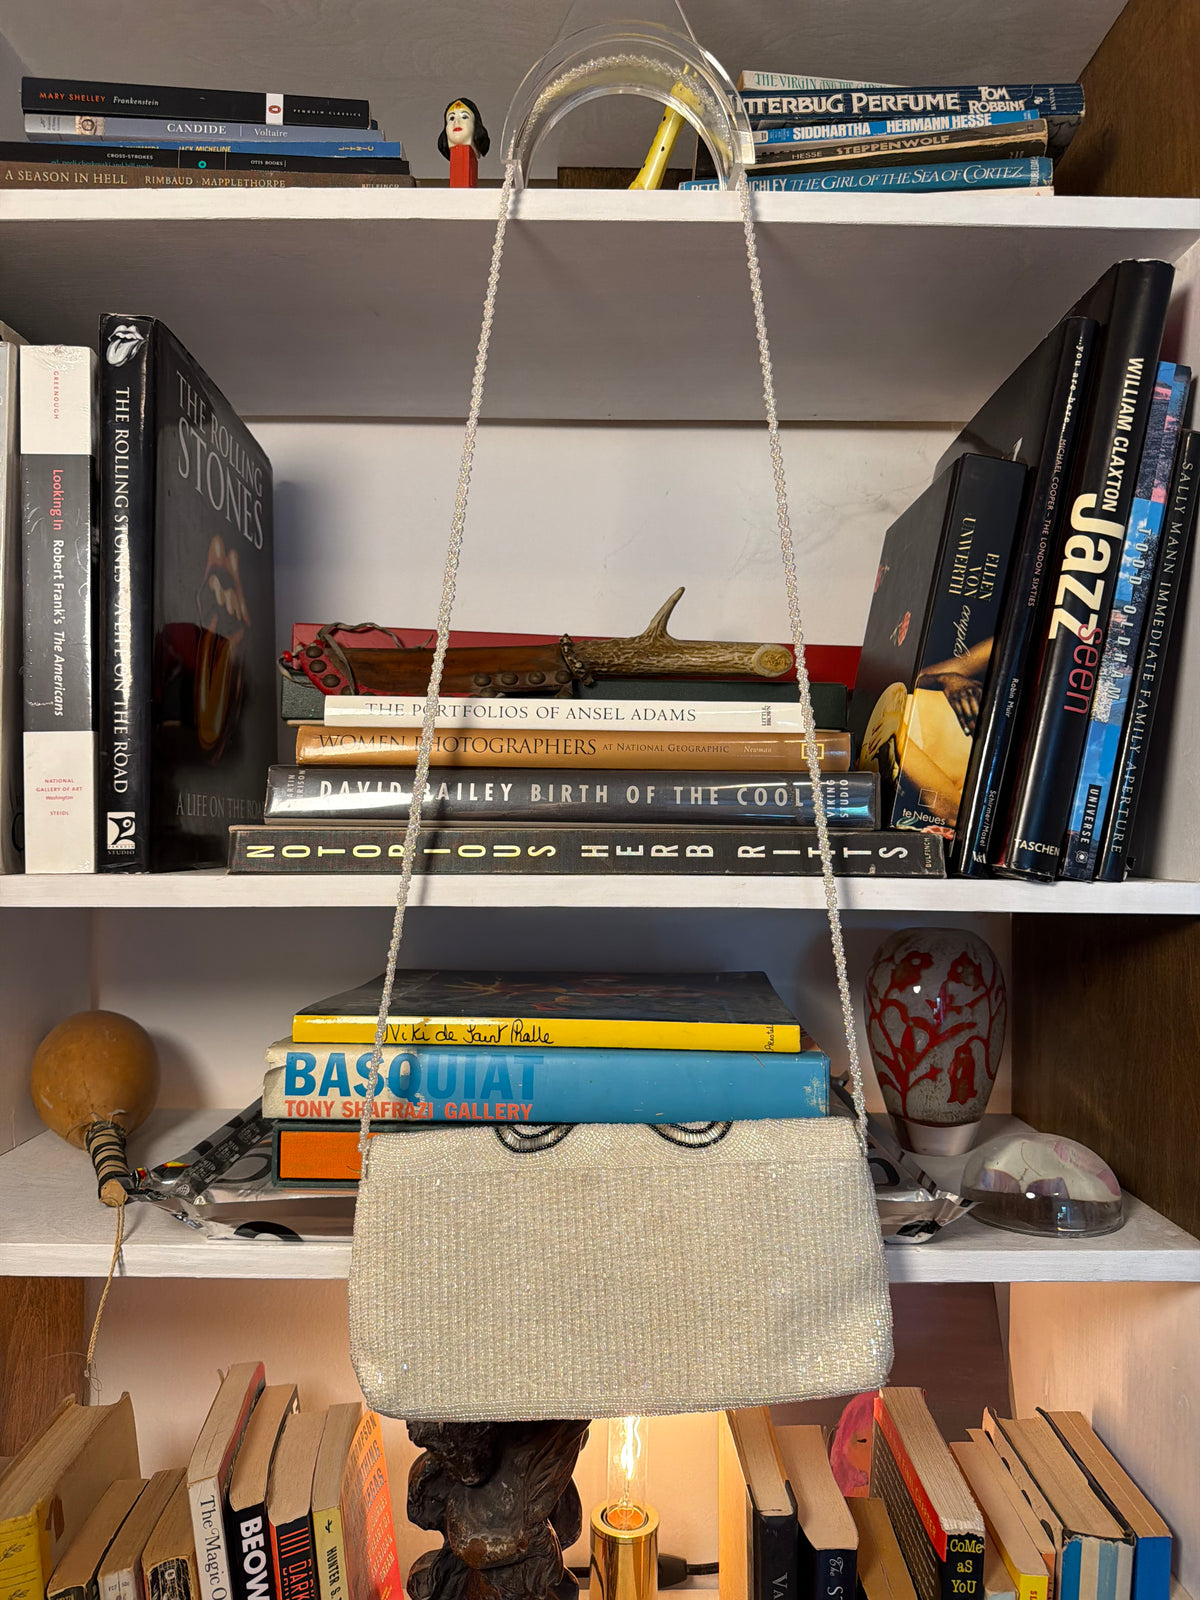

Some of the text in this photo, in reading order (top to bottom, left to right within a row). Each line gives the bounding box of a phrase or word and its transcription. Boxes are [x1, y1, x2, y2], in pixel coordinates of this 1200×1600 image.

[754, 73, 777, 87] THE
[778, 74, 817, 90] VIRGIN
[977, 86, 1010, 101] TOM
[40, 92, 159, 106] MARY SHELLEY Frankenstein
[852, 92, 960, 113] PERFUME
[967, 99, 1026, 114] ROBBINS
[167, 123, 288, 137] CANDIDE Voltaire
[793, 123, 872, 140] SIDDHARTHA
[886, 117, 950, 133] HERMANN
[951, 113, 992, 130] HESSE
[106, 153, 154, 161] CROSS-STROKES
[195, 145, 231, 153] MICHELINE
[792, 135, 950, 160] HESSE STEPPENWOLF
[5, 170, 286, 188] A SEASON IN HELL RIMBAUD MAPPLETHORPE
[789, 178, 820, 191] THE
[820, 175, 863, 191] GIRL
[883, 172, 912, 186] THE
[912, 169, 939, 184] SEA
[940, 169, 963, 182] OF
[963, 165, 1024, 183] CORTEZ
[115, 387, 130, 422] THE
[176, 369, 263, 498] THE ROLLING
[1101, 357, 1145, 513] WILLIAM CLAXTON
[114, 429, 129, 508] ROLLING
[1054, 438, 1067, 474] MICHAEL
[178, 416, 263, 550] STONES
[1049, 476, 1060, 511] COOPER
[1041, 519, 1051, 535] THE
[114, 514, 129, 583] STONES
[948, 516, 976, 595] UNWERTH
[1034, 537, 1048, 575] LONDON
[963, 566, 982, 598] VON
[979, 552, 1000, 601] ELLEN
[1047, 493, 1125, 646] Jazz
[50, 469, 66, 717] Looking In Robert Frank's The Americans
[1027, 577, 1040, 607] SIXTIES
[1106, 604, 1137, 702] OLDHAM
[1111, 461, 1194, 853] SALLY MANN IMMEDIATE FAMILY APERTURE
[114, 663, 129, 691] ON
[365, 703, 697, 721] THE PRTFOLIOS OF ANSEL ADAMS
[1004, 677, 1019, 718] Robin Muir
[114, 699, 129, 735] THE
[319, 734, 405, 749] WOMEN
[602, 744, 613, 752] AT
[616, 743, 664, 752] NATIONAL
[667, 743, 729, 753] GEOGRAPHIC
[114, 741, 129, 794] ROAD
[287, 775, 295, 798] ARTIN
[320, 781, 402, 796] DAVID
[531, 783, 608, 804] BIRTH
[626, 785, 656, 804] OF
[673, 786, 719, 805] THE
[736, 787, 804, 807] COOL
[826, 779, 836, 818] VIKING
[840, 779, 849, 818] STUDIO
[175, 791, 184, 816] A
[187, 793, 207, 816] LIFE
[210, 795, 225, 818] ON
[1080, 788, 1100, 844] UNIVERSE
[246, 844, 909, 859] NOTORIOUS HERB RITTS
[924, 837, 933, 868] BULFINCH
[1014, 838, 1060, 857] TASCHEN
[384, 1018, 554, 1044] Niki de Saint Phalle
[284, 1052, 544, 1103] BASQUIAT
[284, 1100, 533, 1120] TONY SHAFRAZI GALLERY
[200, 1494, 216, 1529] The
[205, 1527, 225, 1585] Magic
[829, 1556, 844, 1577] The
[326, 1545, 342, 1599] HUNTER S.
